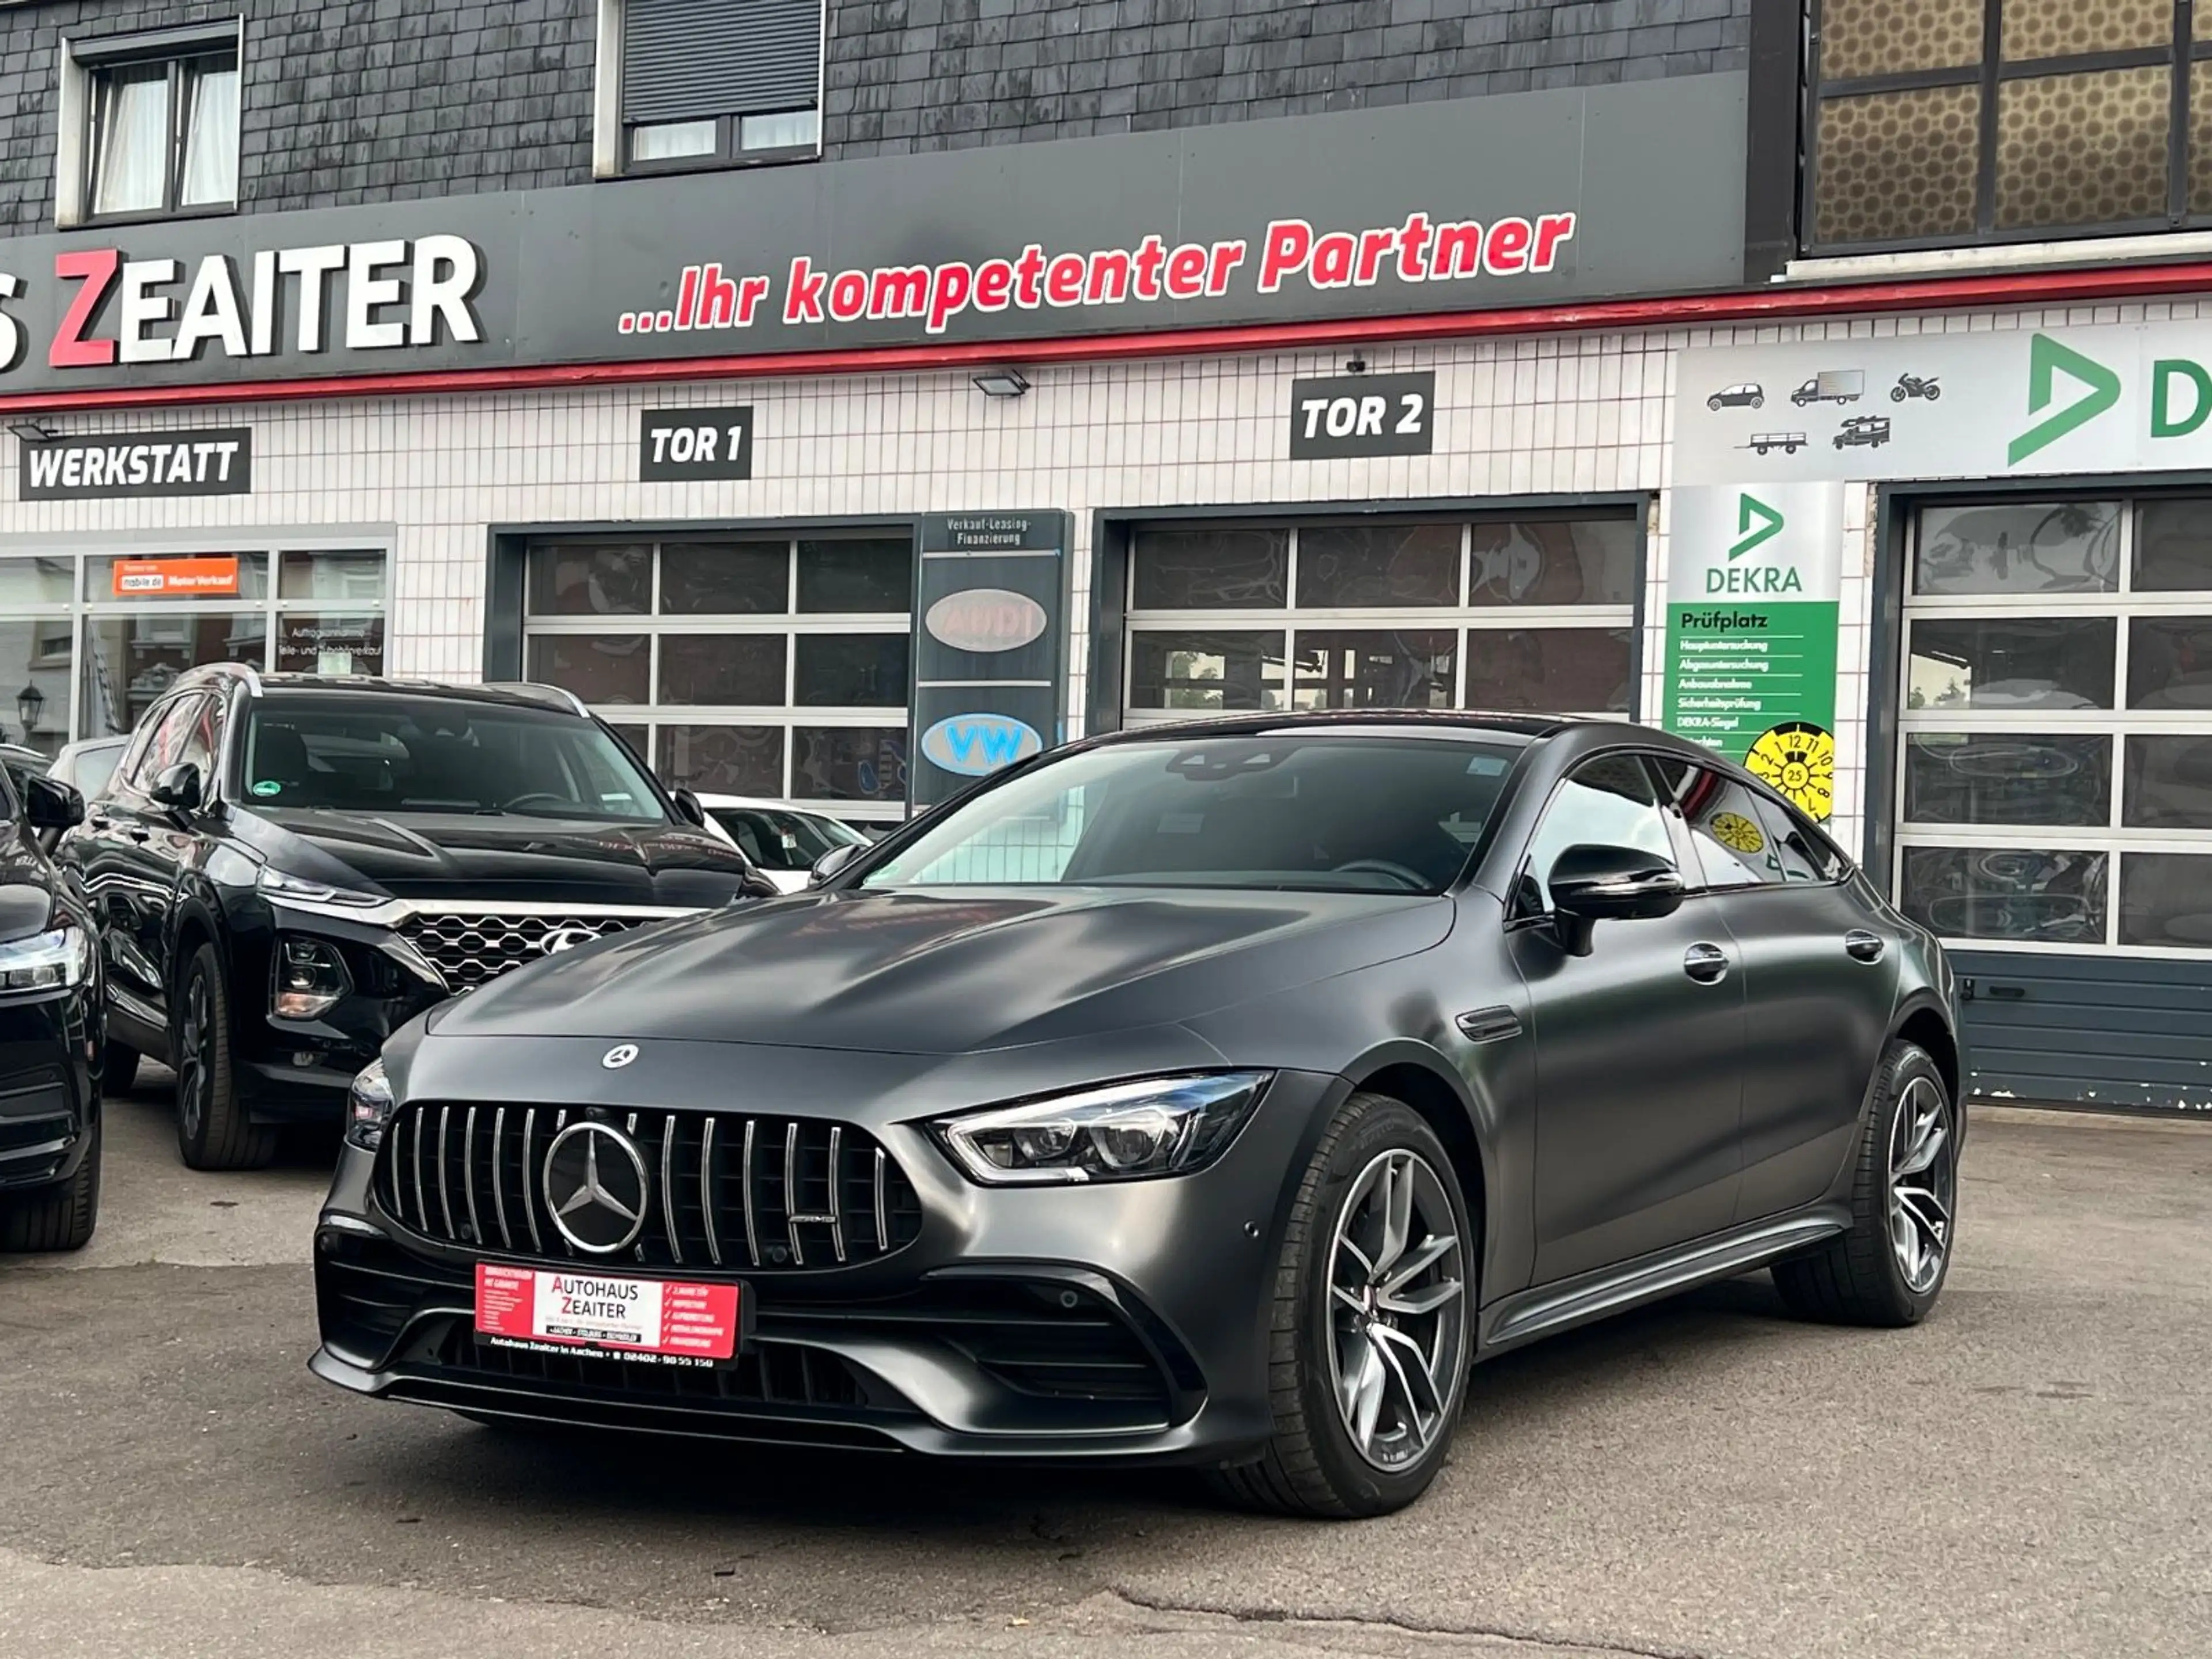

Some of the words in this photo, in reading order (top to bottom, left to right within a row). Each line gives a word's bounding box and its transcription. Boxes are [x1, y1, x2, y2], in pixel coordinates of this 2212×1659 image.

[783, 234, 1247, 334] kompetenter
[1257, 213, 1576, 294] Partner
[50, 234, 480, 367] ZEAITER
[1301, 396, 1386, 438] TOR
[1395, 394, 1423, 434] 2
[651, 427, 716, 463] TOR
[727, 426, 742, 460] 1
[29, 441, 238, 488] WERKSTATT
[957, 532, 1020, 546] Finanzierung
[1706, 566, 1802, 594] DEKRA
[944, 605, 1033, 638] AUDI
[1681, 611, 1768, 632] Prüfplatz
[946, 724, 1022, 763] VW
[1774, 741, 1783, 753] 1
[1789, 735, 1801, 748] 12
[1806, 738, 1819, 753] 11
[1761, 753, 1774, 765] 2
[1818, 750, 1832, 766] 10
[1788, 770, 1802, 782] 25
[1817, 787, 1830, 798] 8
[551, 1276, 638, 1300] AUTOHAUS
[561, 1297, 626, 1319] ZEAITER
